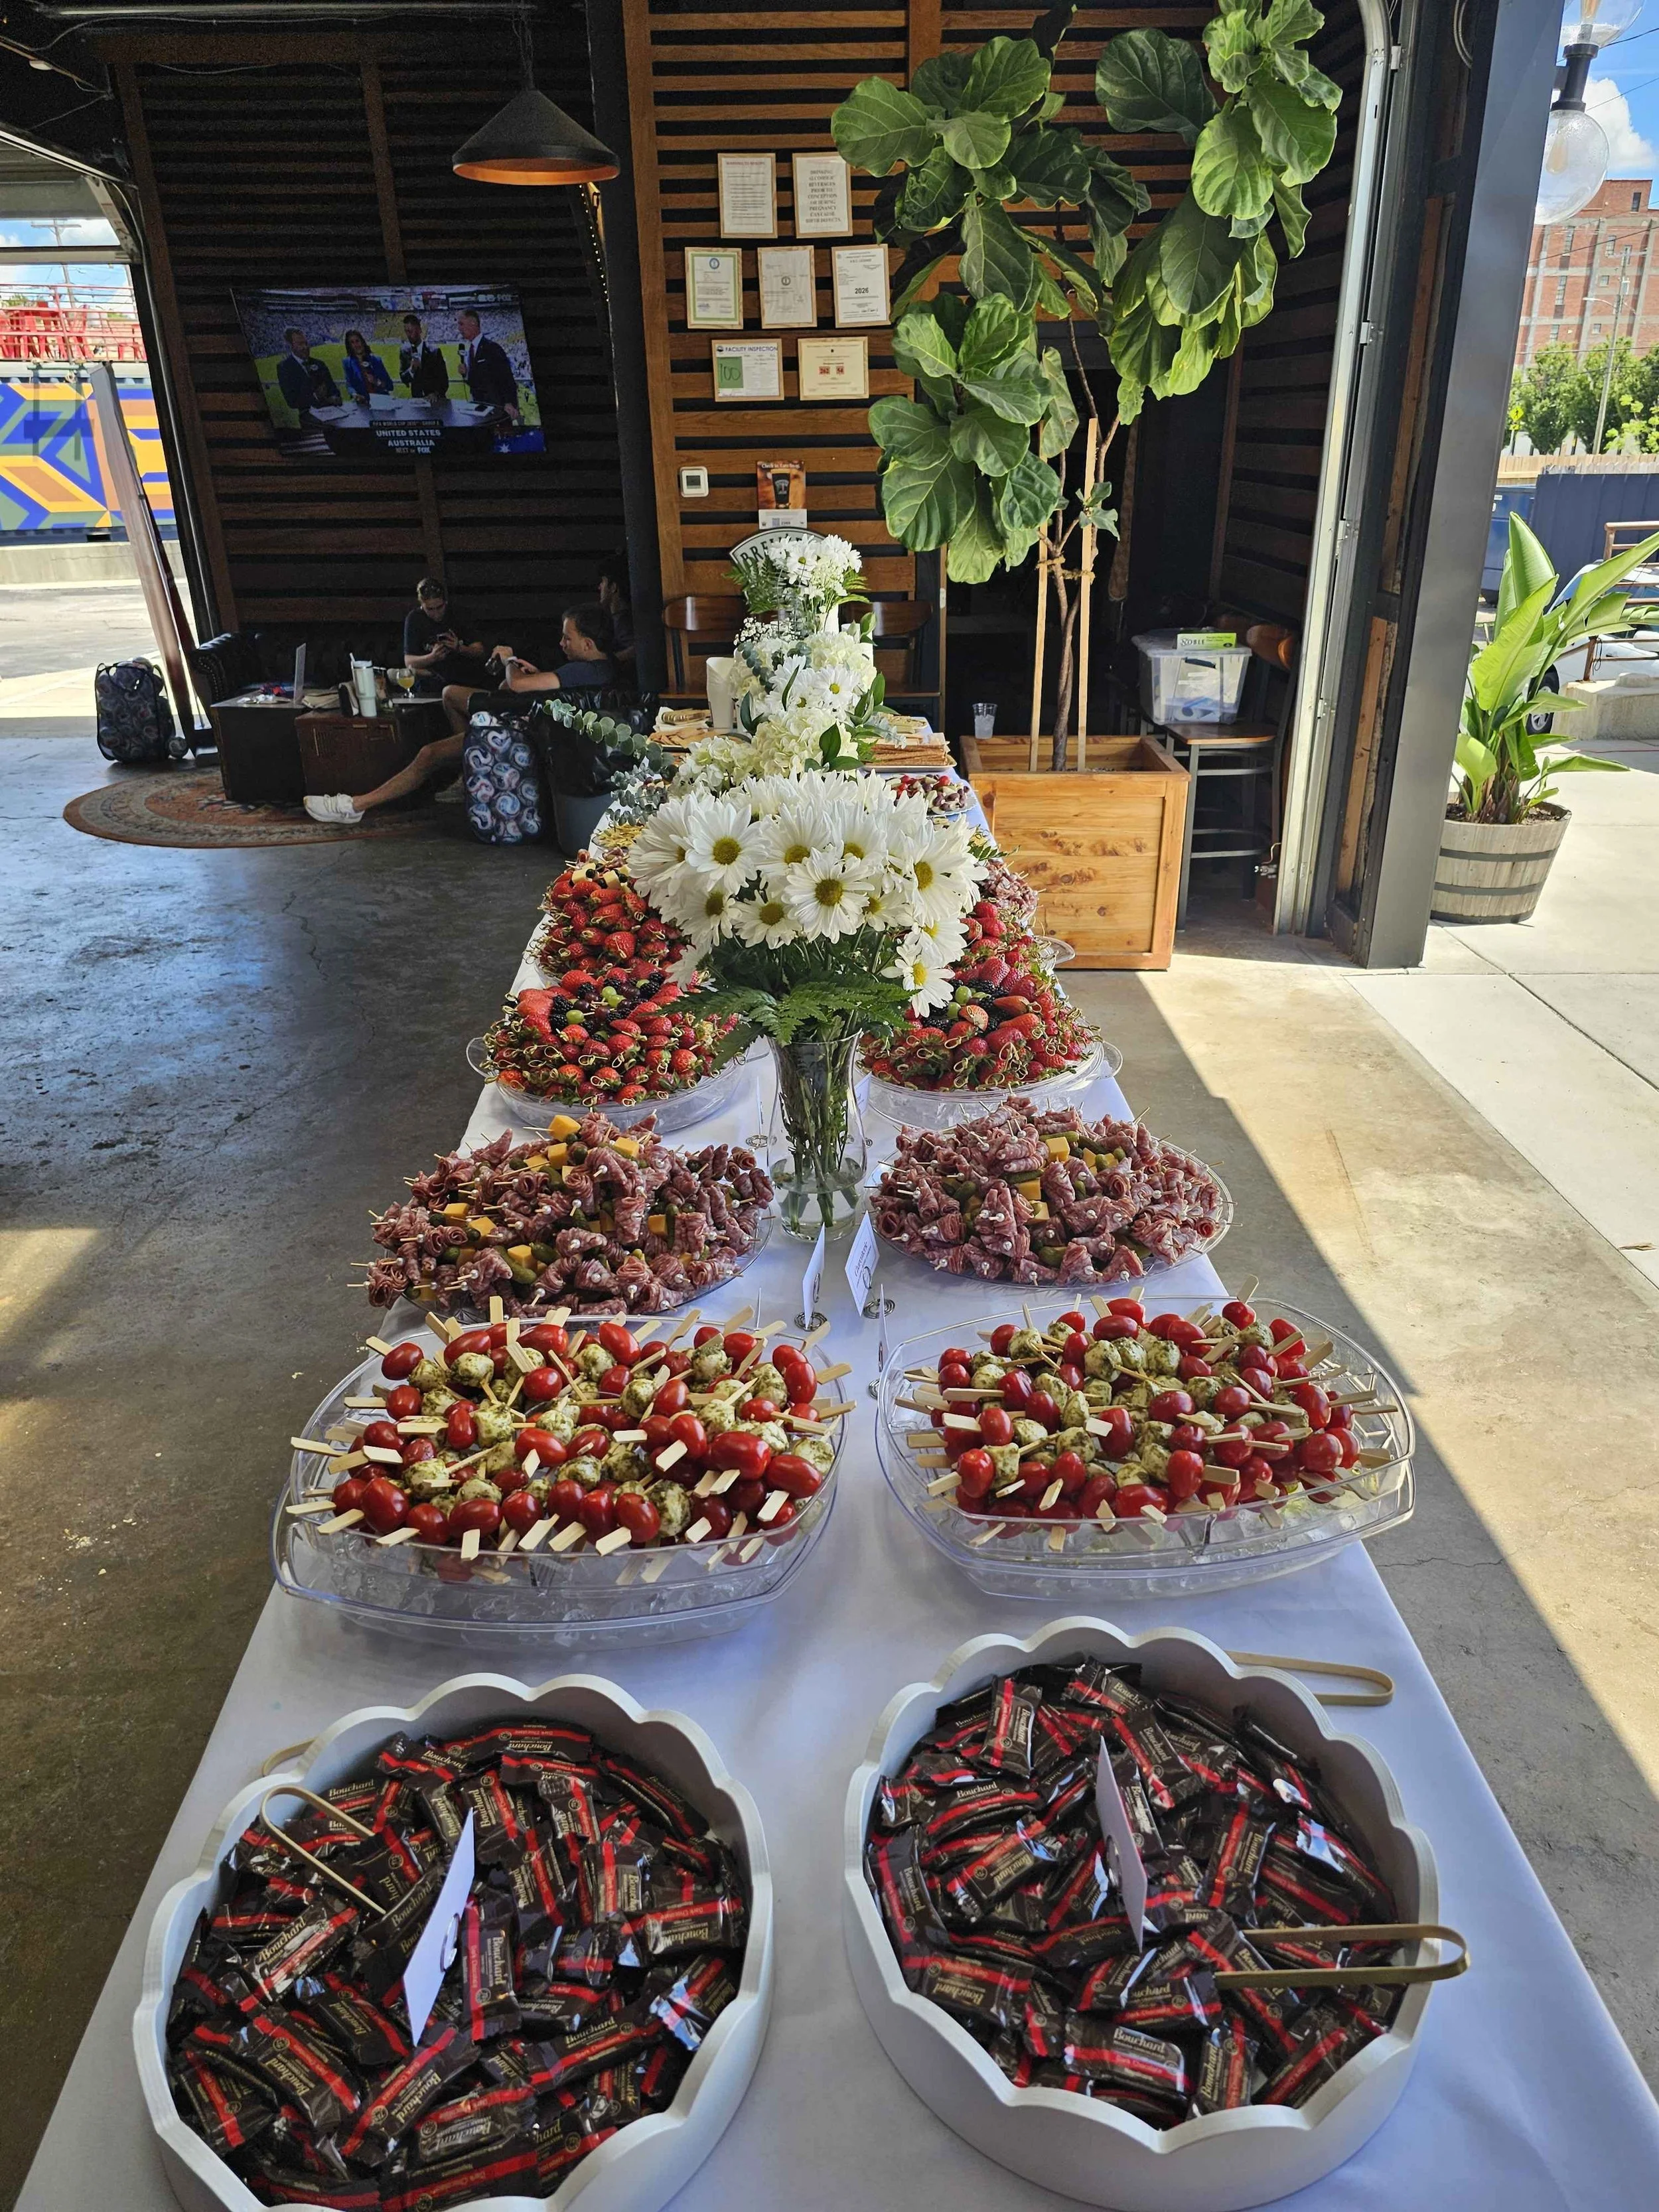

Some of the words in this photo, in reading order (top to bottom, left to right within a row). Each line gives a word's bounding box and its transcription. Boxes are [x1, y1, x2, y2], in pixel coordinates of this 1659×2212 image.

[1017, 1708, 1031, 1744] Bouchard
[1143, 1726, 1172, 1760] Bouchard
[329, 1779, 374, 1797] Bouchard
[956, 1781, 997, 1799] Bouchard
[436, 1798, 459, 1838] Bouchard
[469, 1789, 492, 1827] Bouchard
[1243, 1833, 1264, 1875] Bouchard
[904, 1866, 925, 1911] Bouchard
[258, 1917, 306, 1961] Bouchard
[493, 1937, 507, 1985] Bouchard
[932, 1982, 985, 2005] Bouchard
[565, 2016, 615, 2045] Bouchard
[1114, 2028, 1166, 2053] Bouchard
[266, 2057, 310, 2096] Bouchard
[1116, 2055, 1130, 2065] Dark
[1200, 2042, 1218, 2099] Bouchard
[396, 2071, 441, 2123] Bouchard
